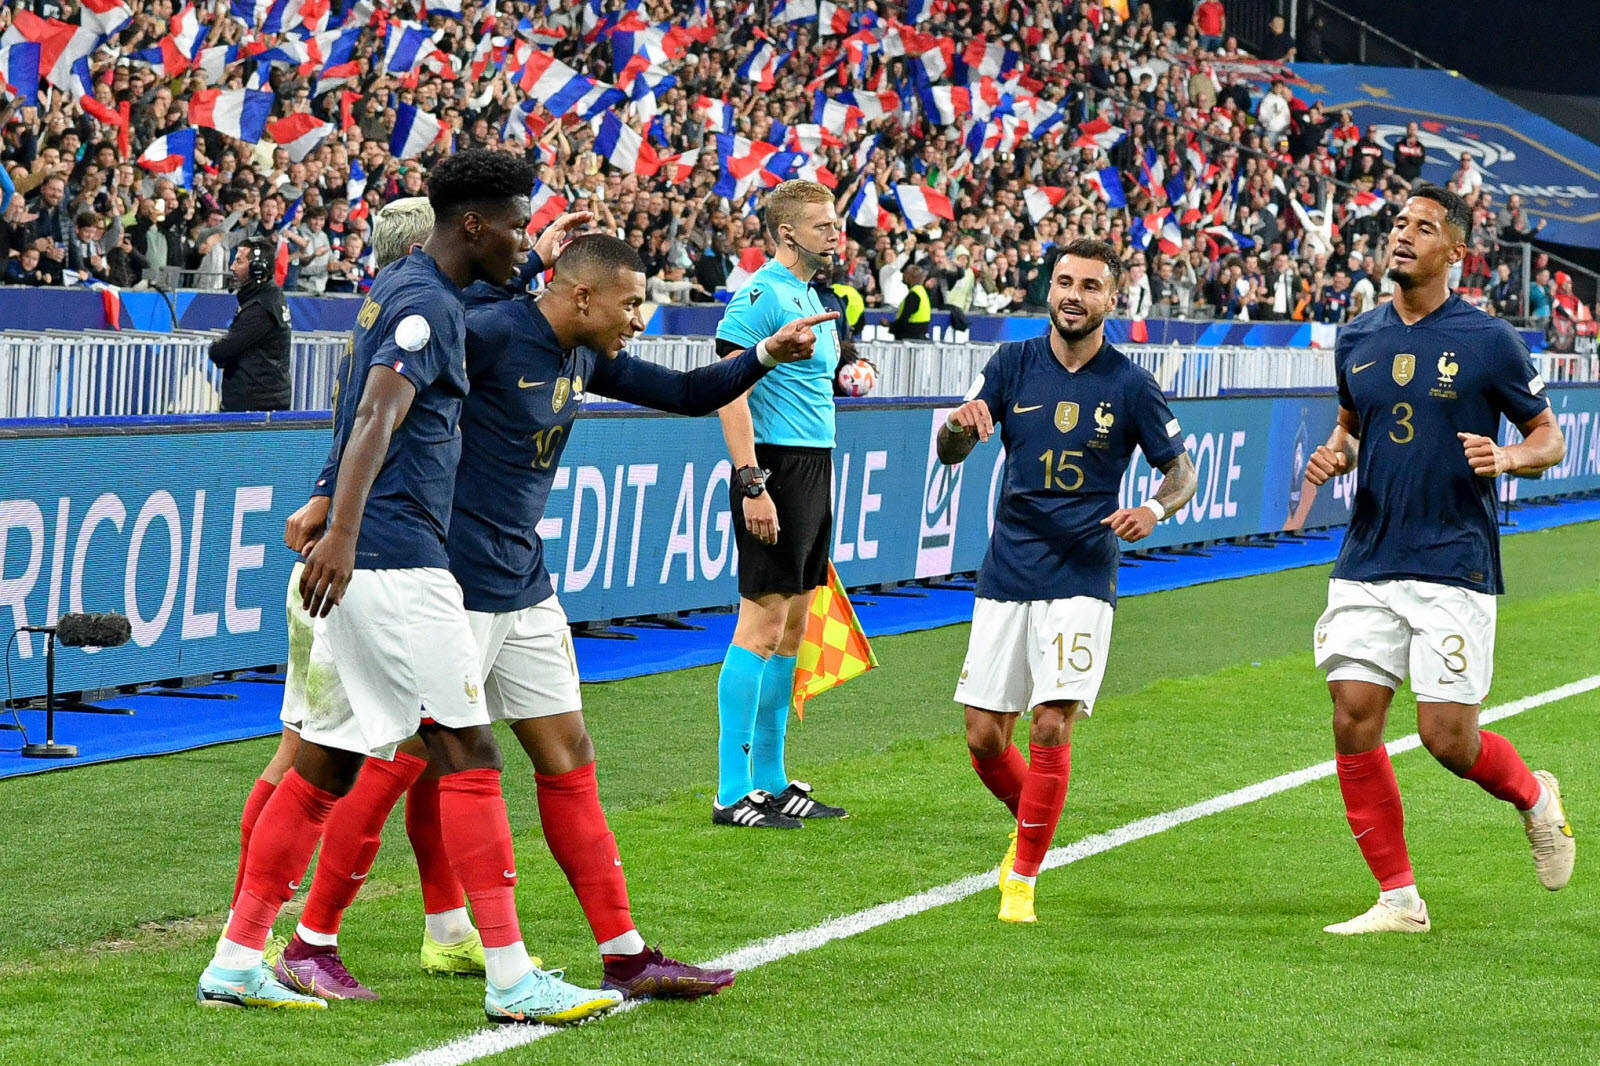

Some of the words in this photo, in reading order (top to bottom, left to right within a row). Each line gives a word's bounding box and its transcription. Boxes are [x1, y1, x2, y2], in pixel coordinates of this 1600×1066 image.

[1388, 402, 1415, 443] 3
[531, 426, 563, 468] 10
[1038, 449, 1084, 490] 15
[535, 463, 658, 593] EDIT
[659, 450, 888, 581] AGLE
[560, 632, 576, 677] 1
[1051, 632, 1093, 672] 15
[1441, 634, 1468, 674] 3
